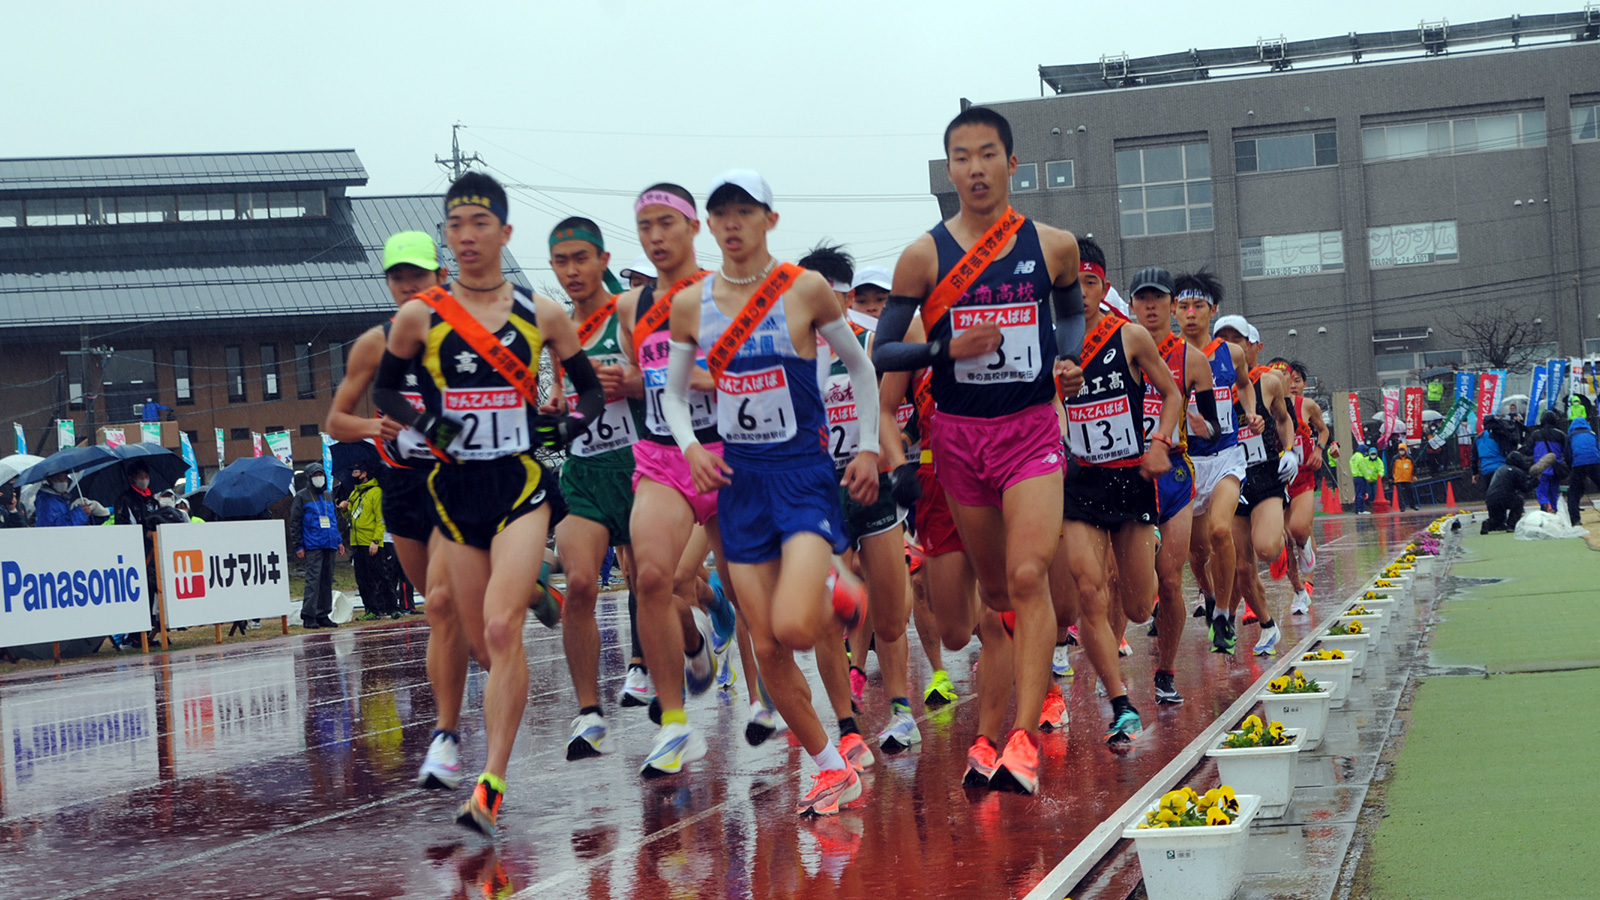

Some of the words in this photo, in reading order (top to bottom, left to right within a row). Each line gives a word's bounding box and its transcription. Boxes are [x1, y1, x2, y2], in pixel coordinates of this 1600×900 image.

[967, 370, 1034, 382] 春の高校伊那駅伝
[461, 411, 521, 450] 21-1
[737, 396, 786, 432] 6-1
[1081, 419, 1132, 454] 13-1
[1, 555, 141, 613] Panasonic
[208, 551, 282, 589] ハナマルキ
